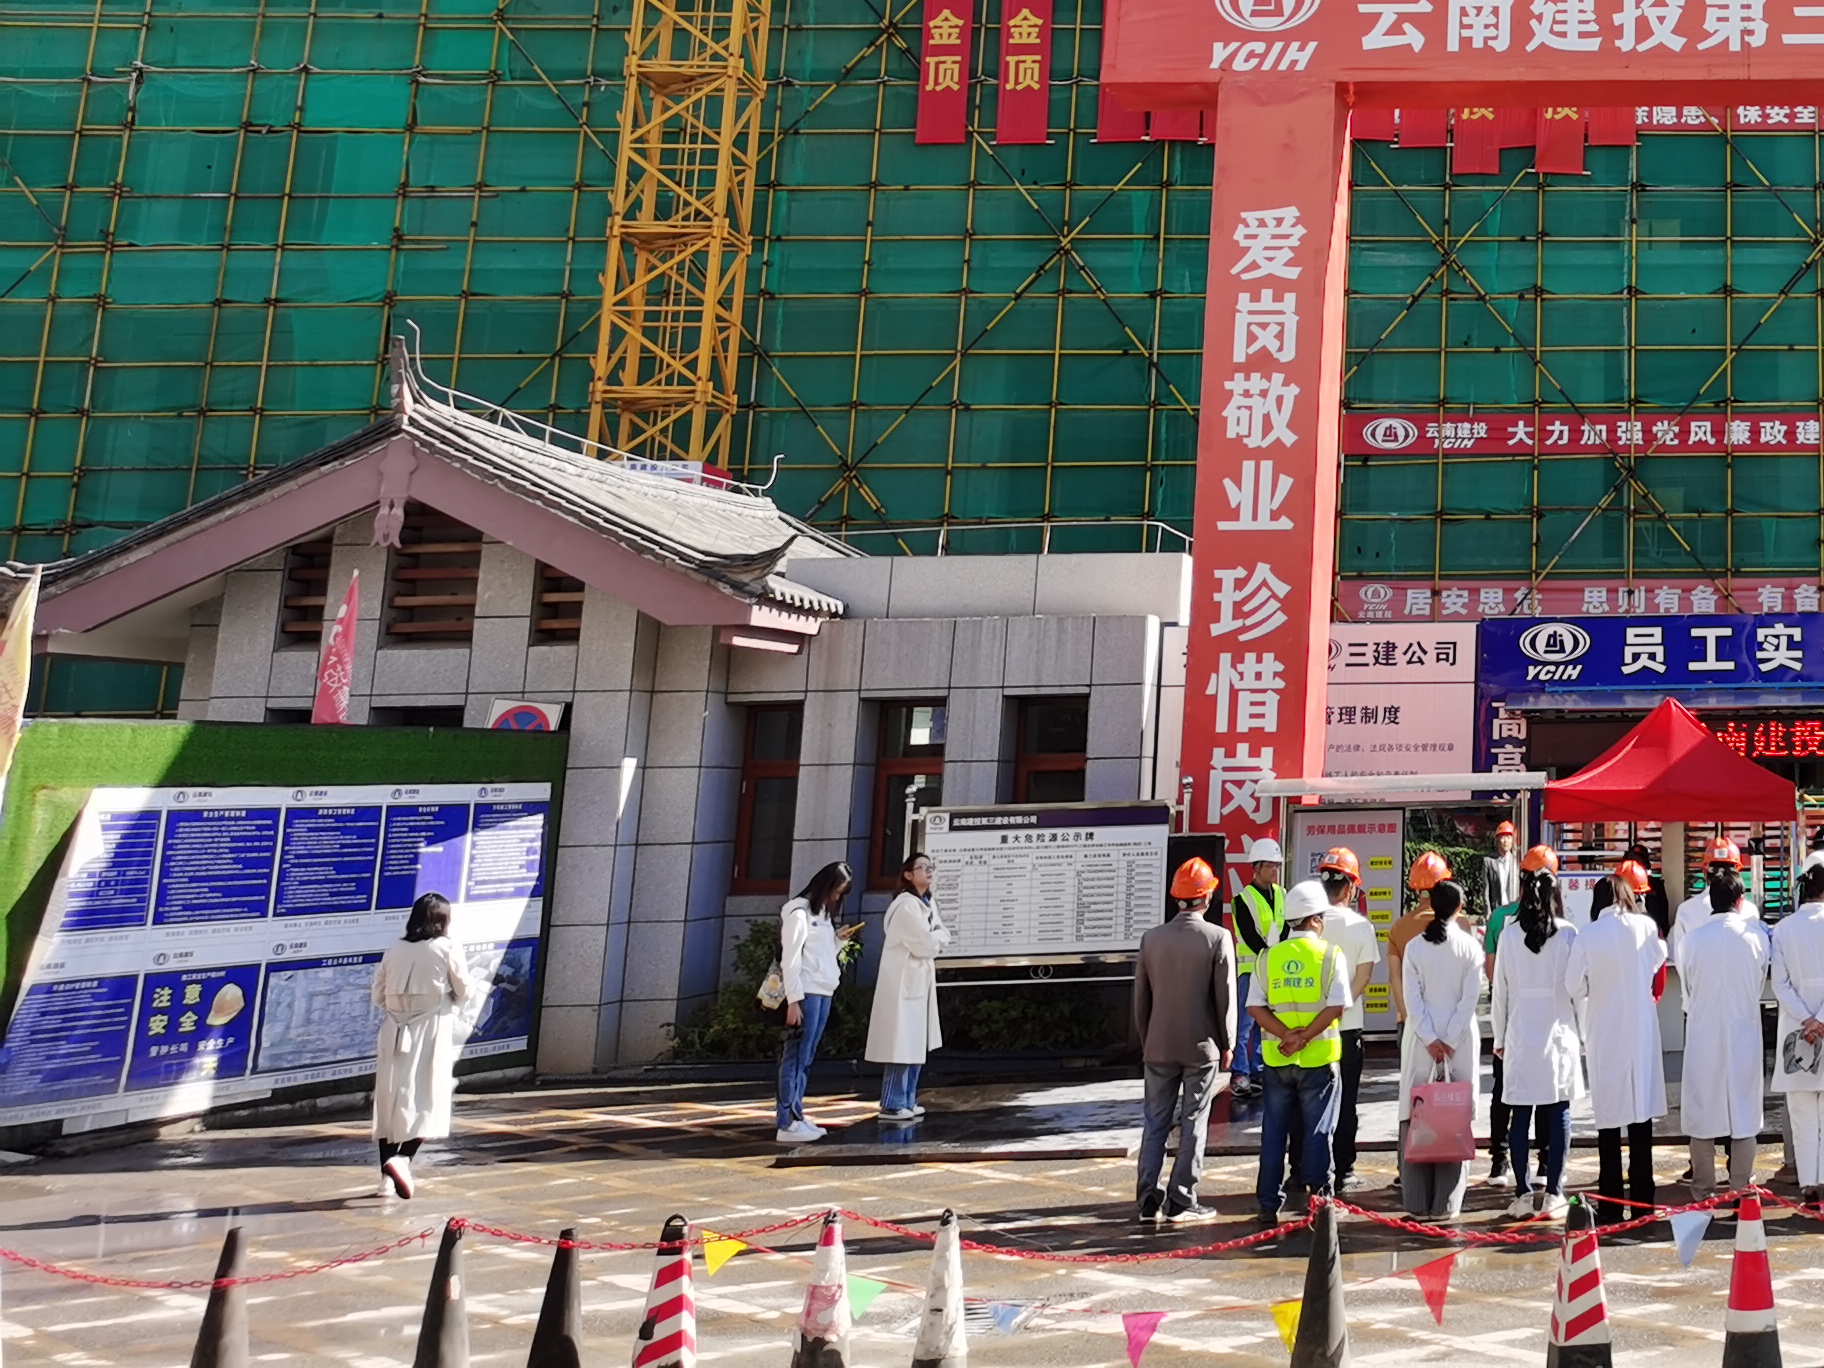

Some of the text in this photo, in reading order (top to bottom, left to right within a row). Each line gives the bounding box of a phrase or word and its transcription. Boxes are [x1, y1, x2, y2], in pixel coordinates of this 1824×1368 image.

[1209, 40, 1319, 72] YCIH
[1216, 205, 1308, 532] 爱岗敬业
[1425, 421, 1488, 439] 云南建投
[1433, 437, 1476, 449] YCIH
[1403, 586, 1543, 616] 居安思危
[1581, 585, 1718, 615] 思则有备
[1344, 640, 1458, 668] 三建公司
[1525, 664, 1583, 682] YCIH
[1000, 831, 1096, 845] 重大危险源公示牌
[152, 983, 203, 1008] 注意
[1271, 976, 1315, 990] 云南建投
[148, 1010, 199, 1036] 安全
